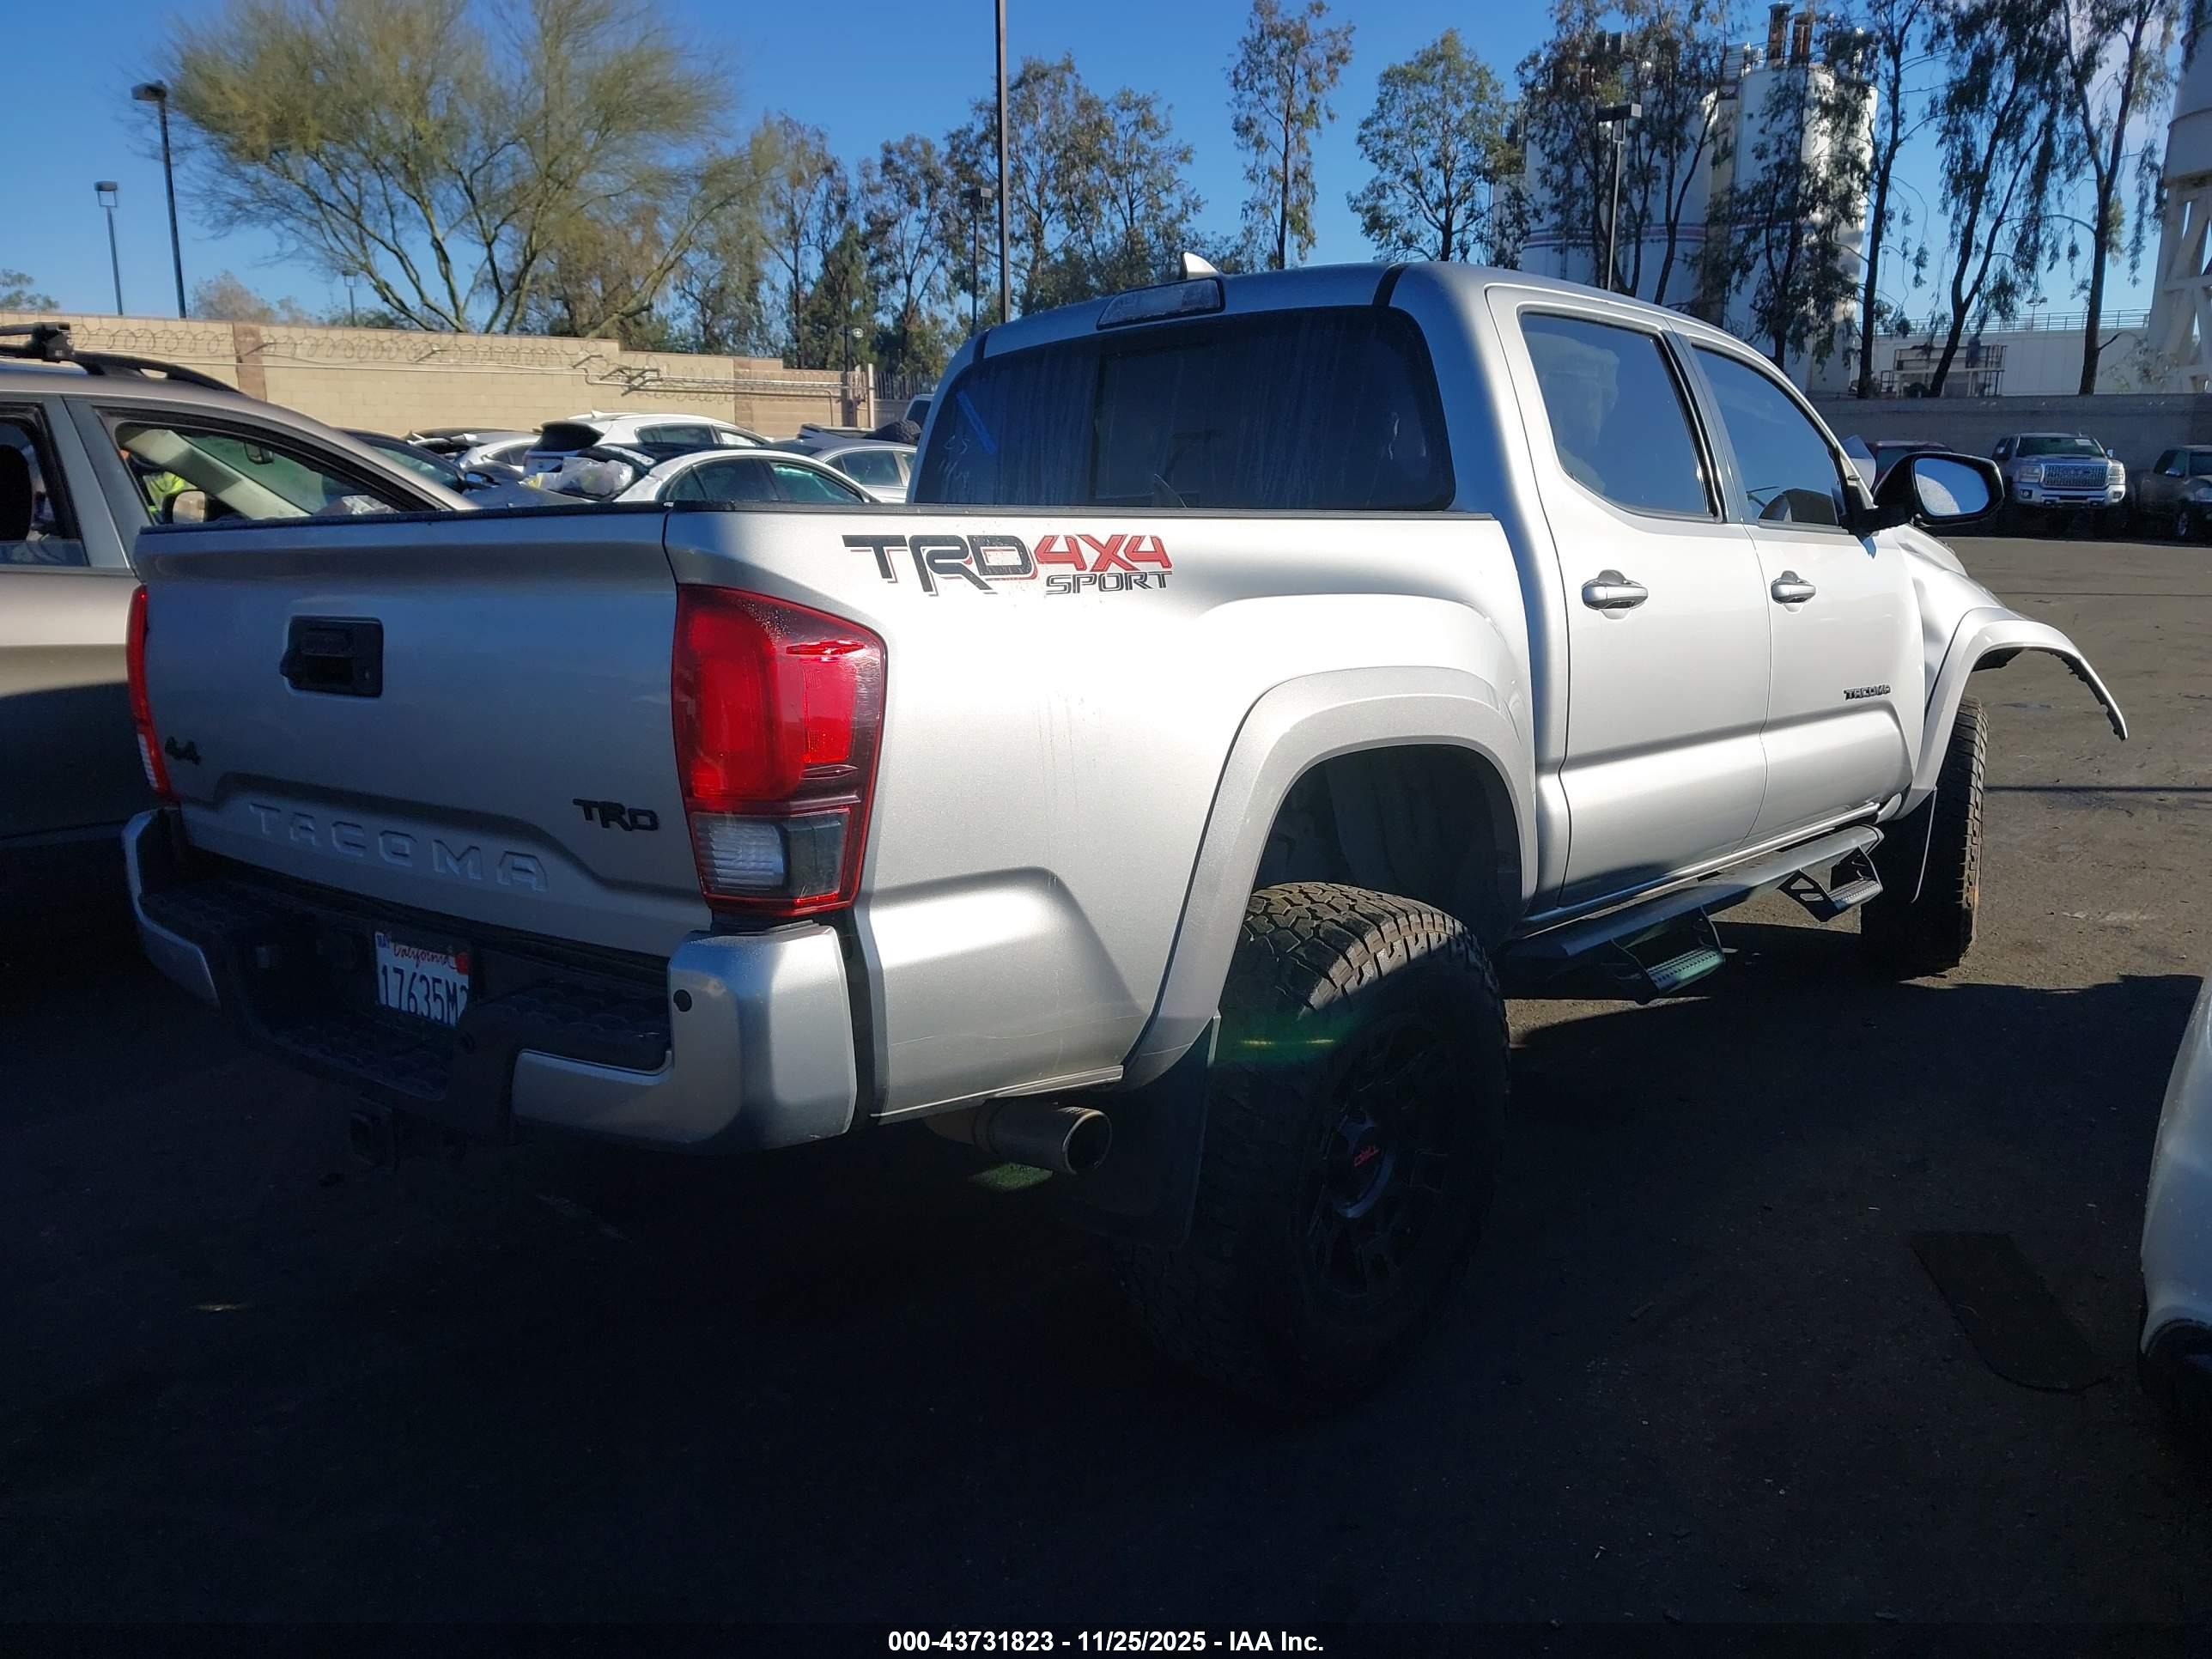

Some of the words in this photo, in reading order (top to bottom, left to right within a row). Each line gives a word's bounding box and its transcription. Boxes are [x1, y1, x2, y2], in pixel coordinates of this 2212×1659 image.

[842, 535, 1037, 596] TRD
[1045, 571, 1173, 595] SPORT
[1844, 684, 1891, 701] TACOMA
[573, 798, 659, 831] TRD
[249, 802, 548, 893] TACOMA
